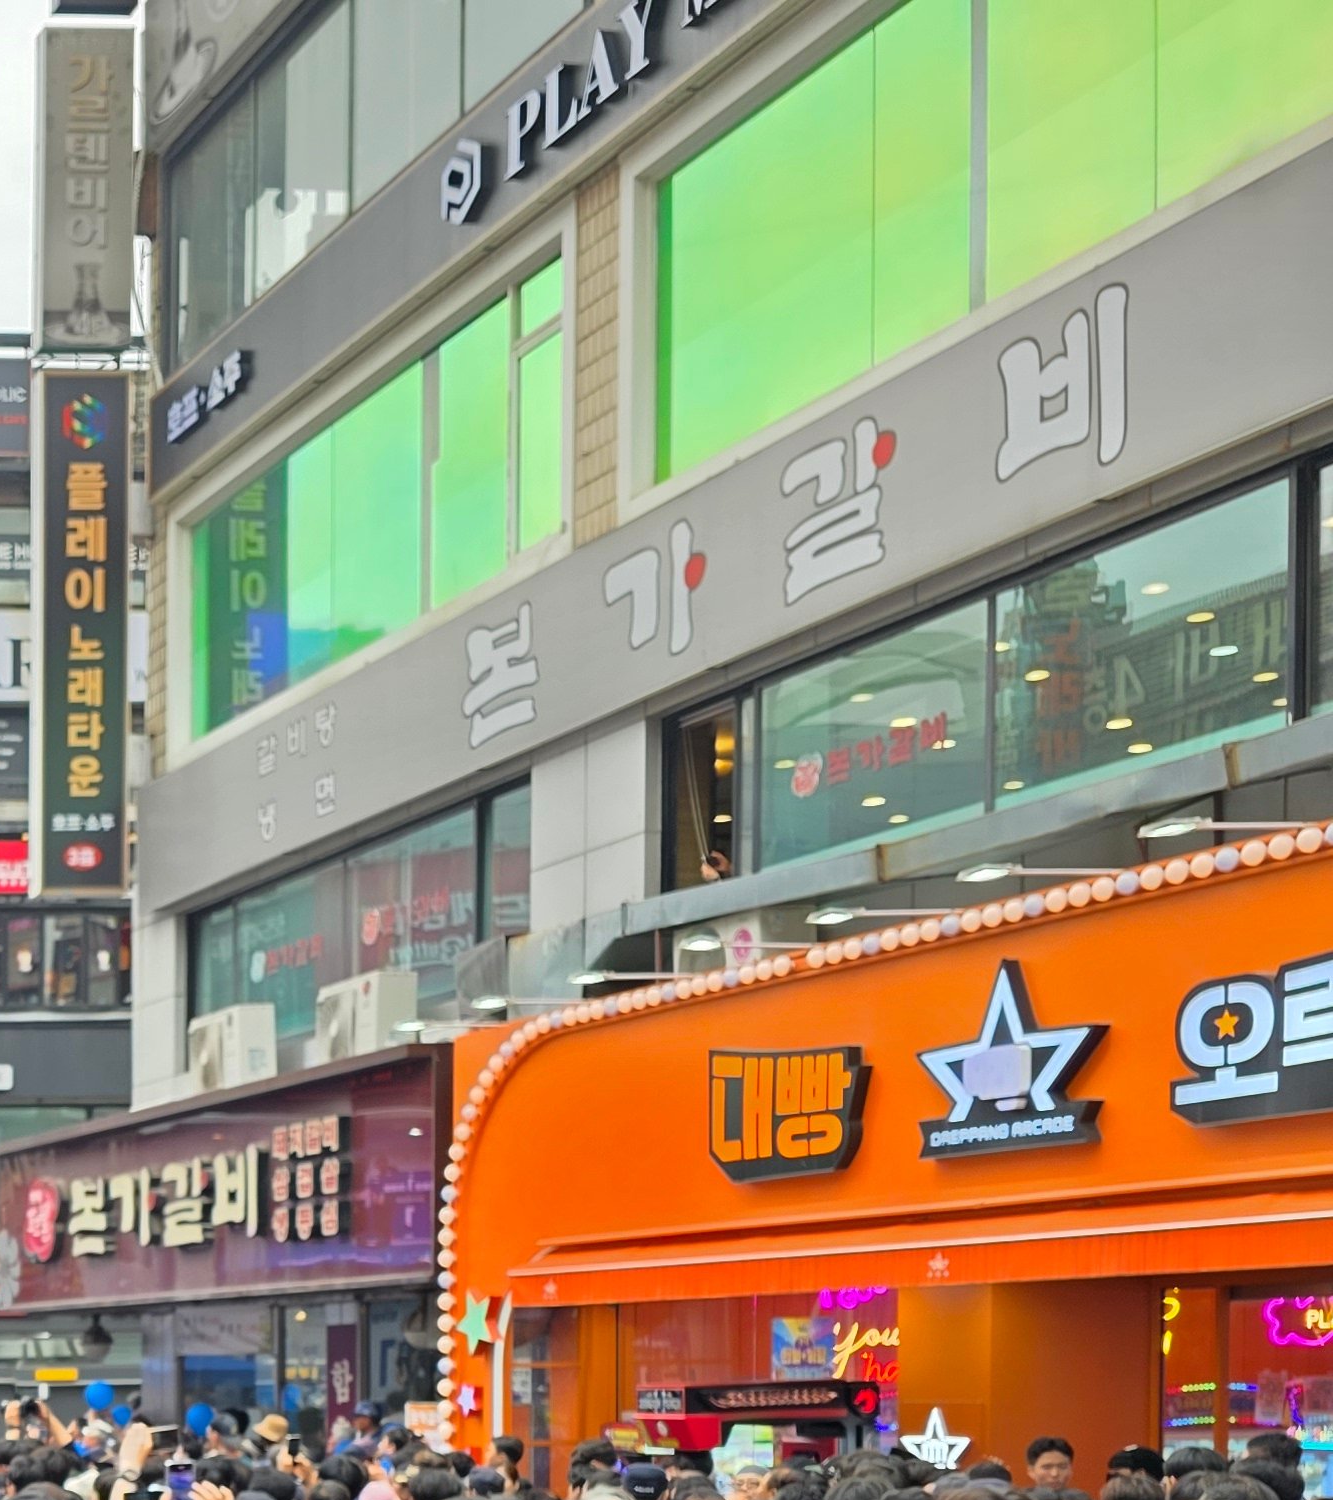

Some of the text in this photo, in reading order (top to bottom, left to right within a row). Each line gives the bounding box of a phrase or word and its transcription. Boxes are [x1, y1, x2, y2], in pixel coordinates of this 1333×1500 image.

[503, 0, 663, 182] PLAY
[65, 461, 109, 613] 플레이
[461, 282, 1131, 752] 본가갈비
[65, 624, 106, 799] 노래타운
[712, 1052, 851, 1163] 대빵
[67, 1143, 259, 1258] 본가갈비
